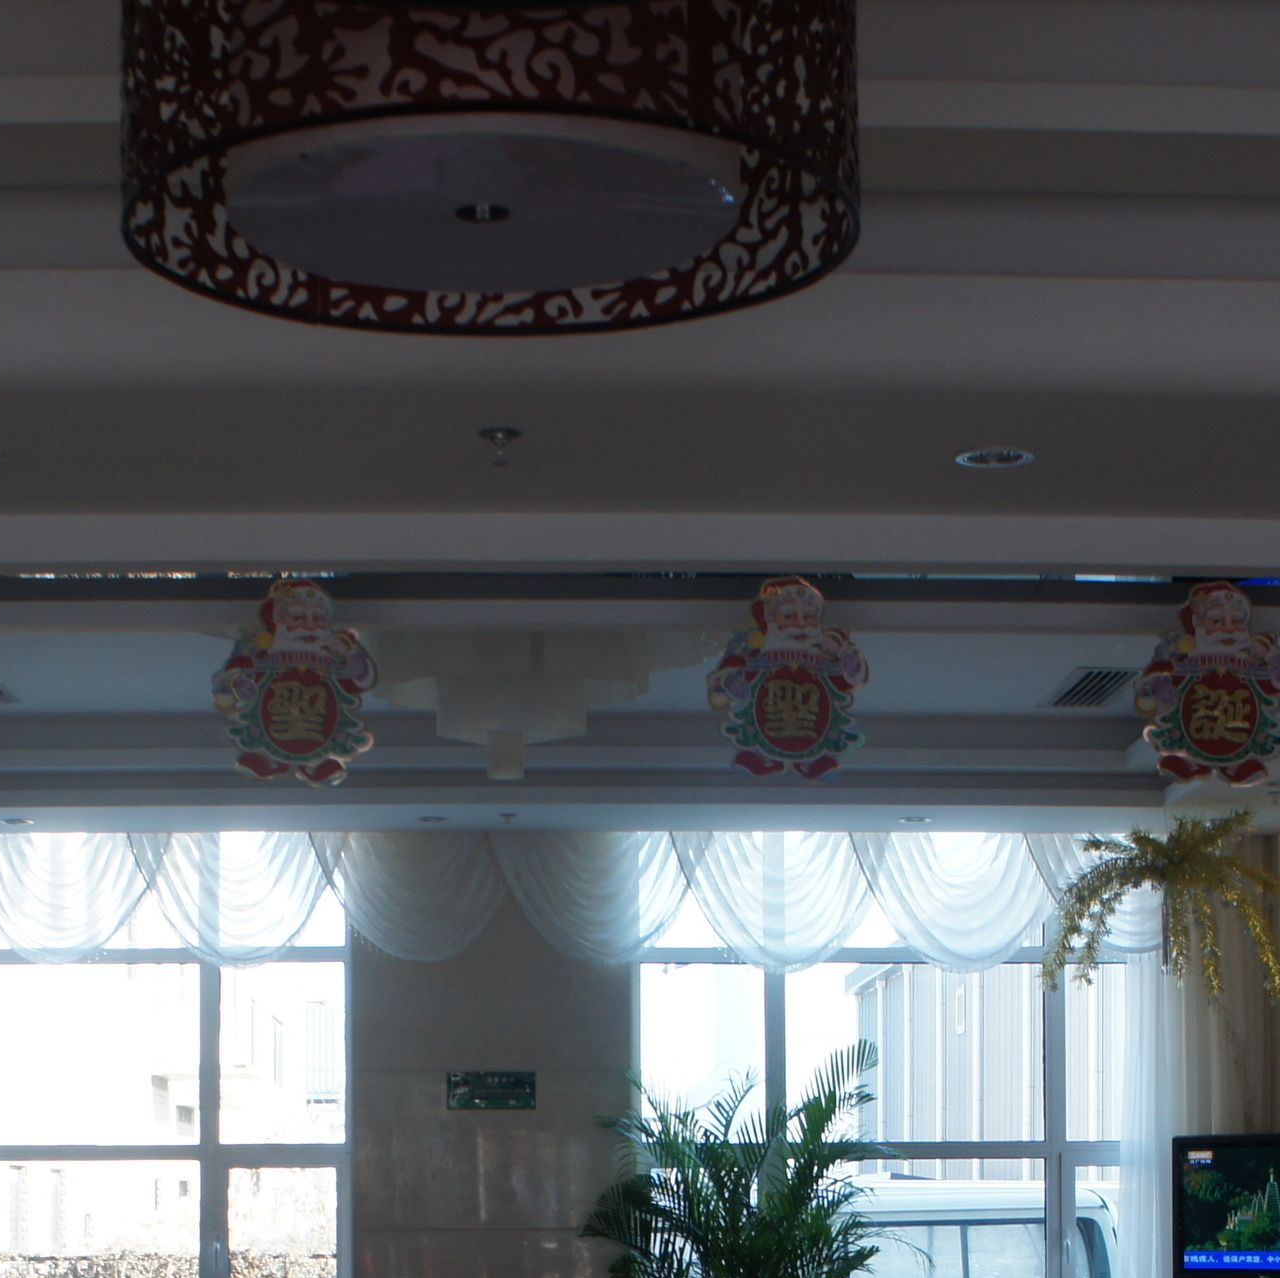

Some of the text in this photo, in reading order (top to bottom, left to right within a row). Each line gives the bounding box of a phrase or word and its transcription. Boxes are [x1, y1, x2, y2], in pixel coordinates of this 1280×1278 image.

[268, 680, 329, 742] 聖
[762, 678, 821, 740] 聖
[1189, 684, 1253, 742] 誕
